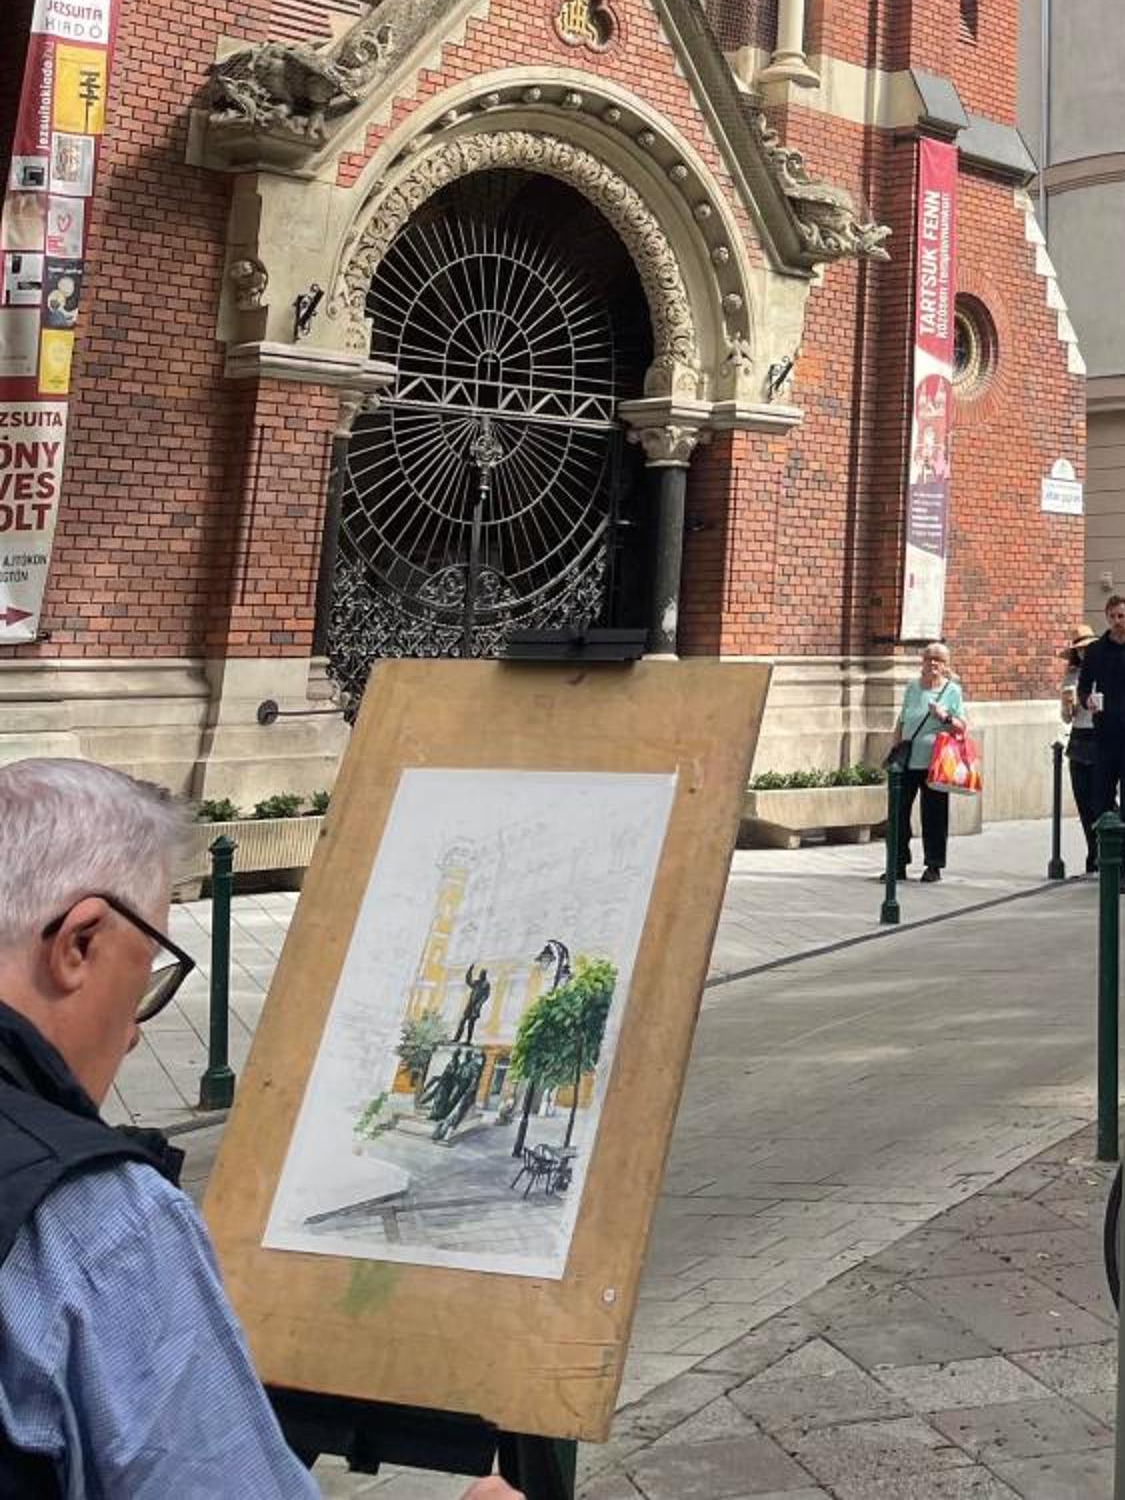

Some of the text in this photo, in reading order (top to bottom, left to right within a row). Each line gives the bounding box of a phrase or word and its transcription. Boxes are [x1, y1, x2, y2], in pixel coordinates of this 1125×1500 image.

[47, 0, 102, 20] JEZSUITA
[920, 190, 940, 336] TARTSUK FENN
[0, 411, 63, 427] ZSUITA
[0, 435, 60, 469] ÖNY
[0, 503, 52, 533] OLT
